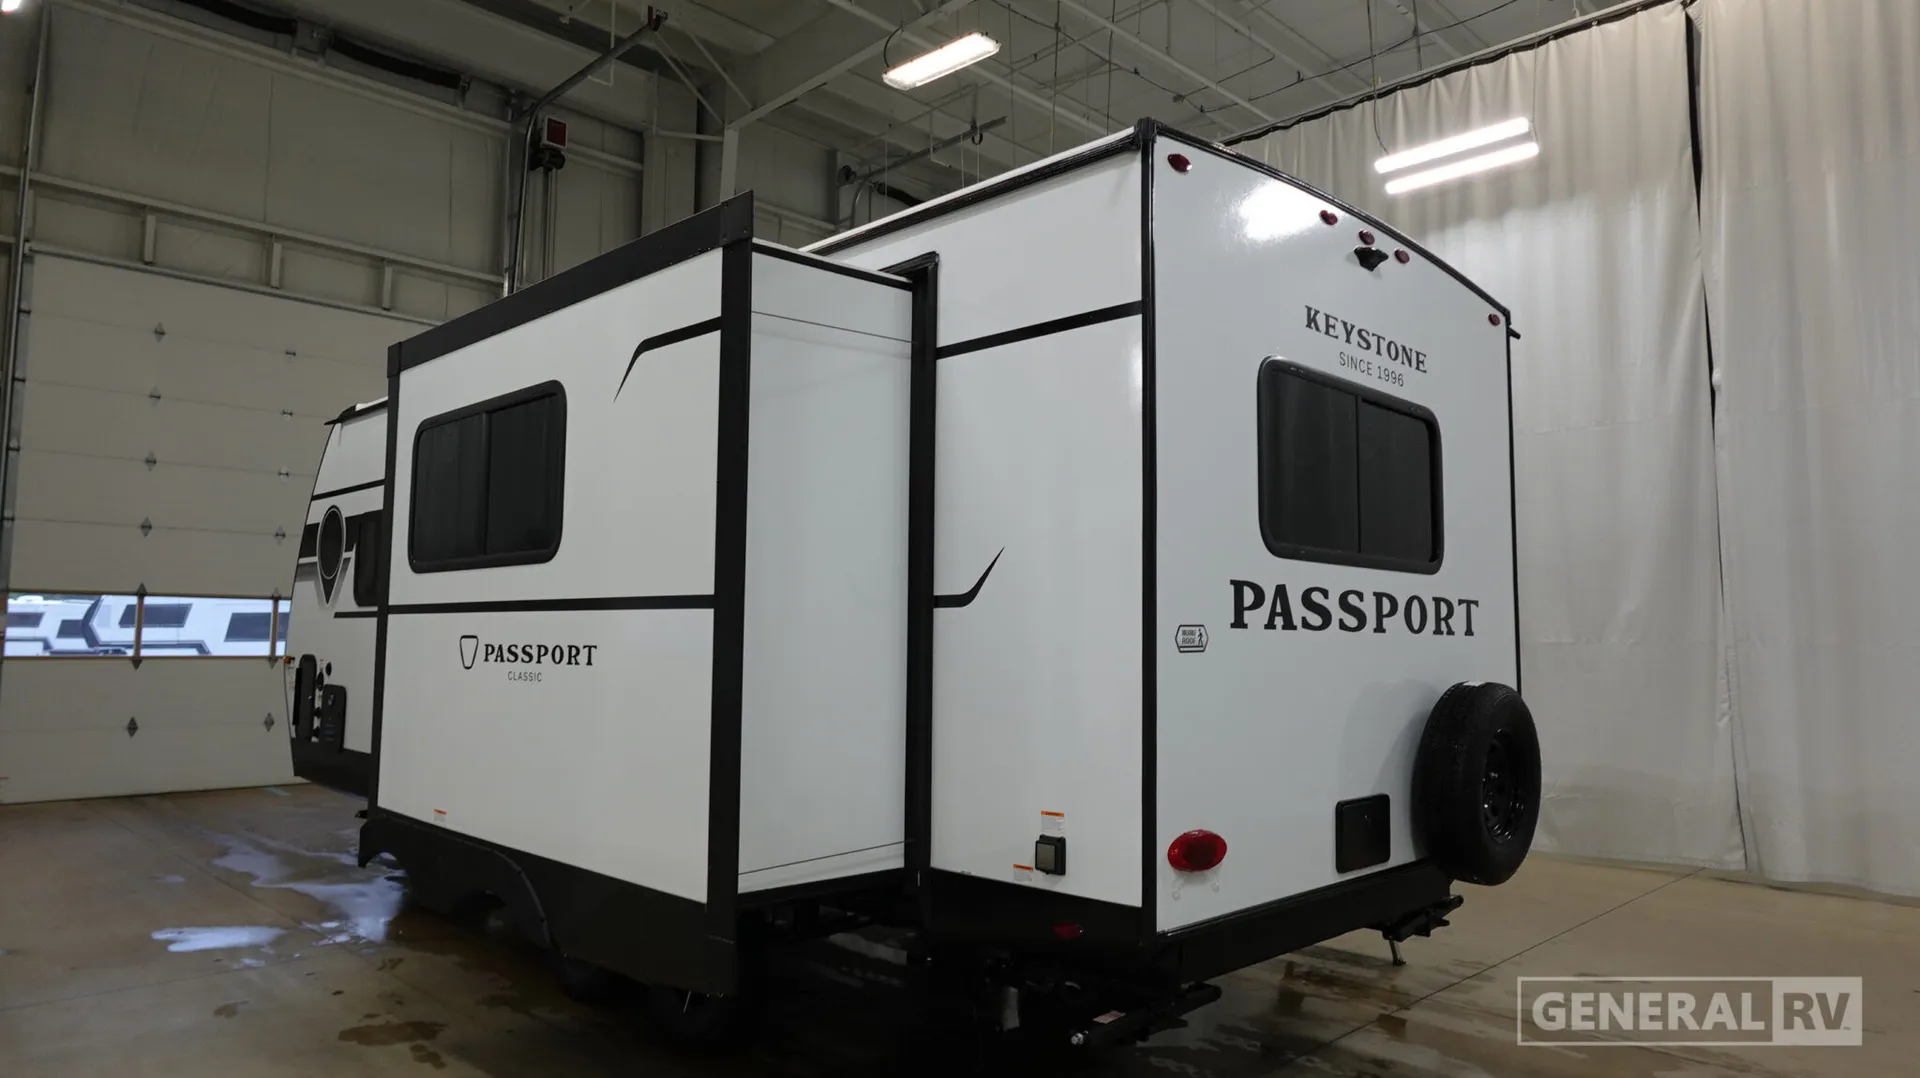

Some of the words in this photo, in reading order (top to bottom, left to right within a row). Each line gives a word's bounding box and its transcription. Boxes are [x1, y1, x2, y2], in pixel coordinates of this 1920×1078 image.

[1305, 305, 1427, 373] KEYSTONE
[1339, 351, 1372, 376] SINCE
[1377, 366, 1404, 387] 1996
[1230, 579, 1479, 637] PASSPORT
[484, 644, 598, 666] PASSPORT
[508, 671, 542, 683] CLASSIC
